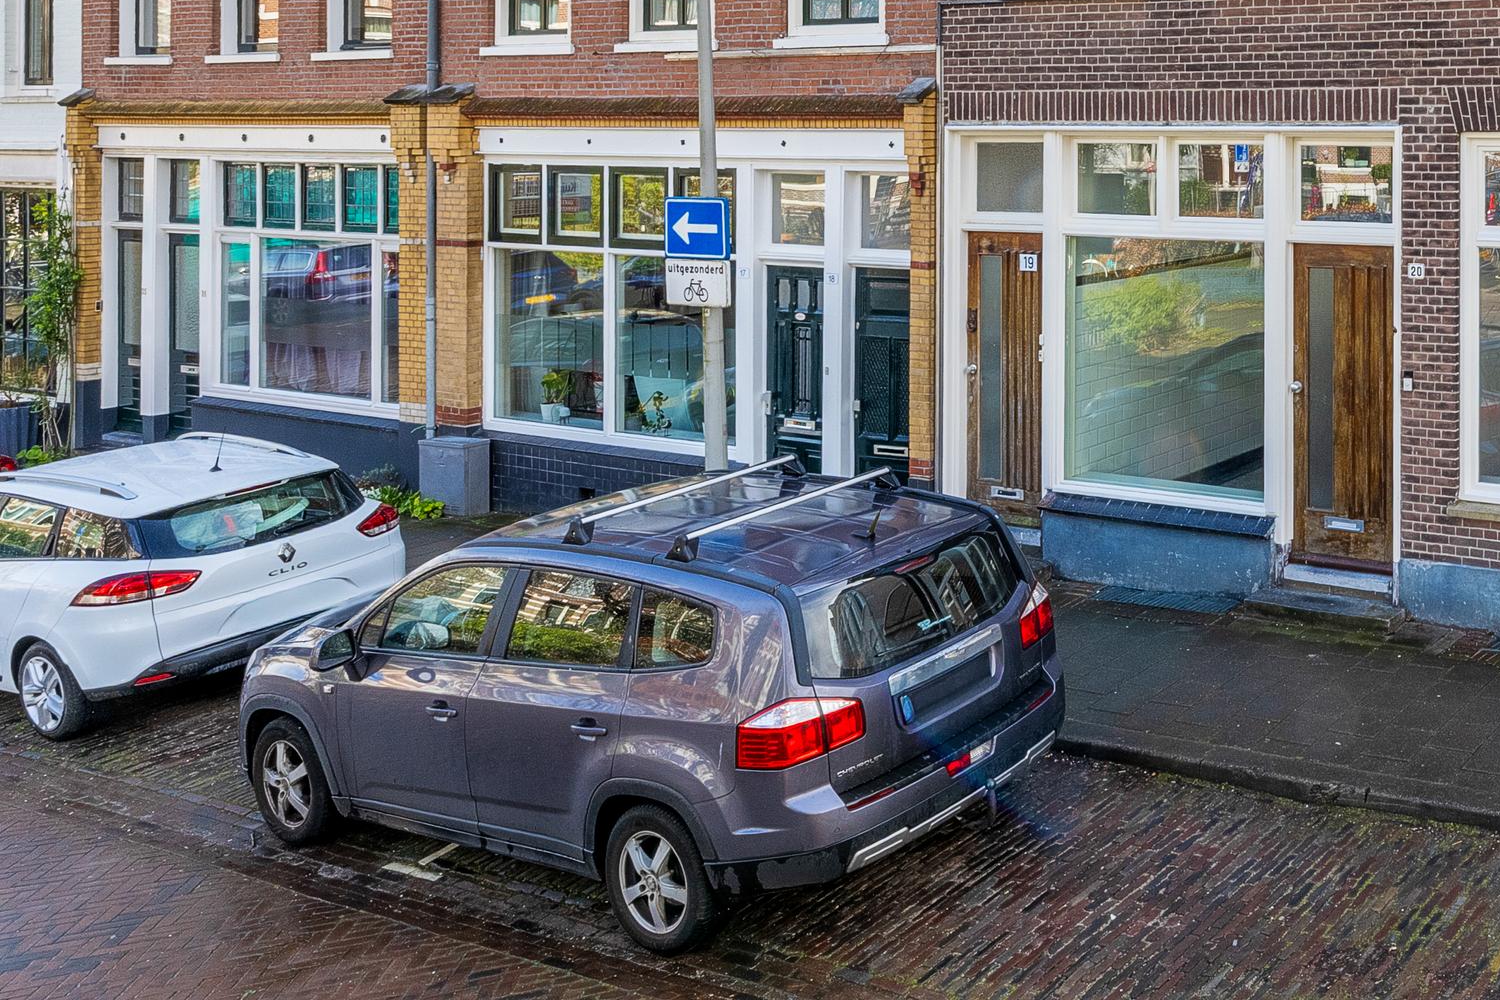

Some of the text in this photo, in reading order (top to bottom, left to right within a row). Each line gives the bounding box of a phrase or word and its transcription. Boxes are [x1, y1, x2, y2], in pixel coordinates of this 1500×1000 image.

[1023, 256, 1034, 269] 19
[667, 263, 724, 276] uitgezonderd
[739, 269, 747, 277] 17
[1410, 266, 1422, 277] 20
[268, 561, 308, 577] CLIO
